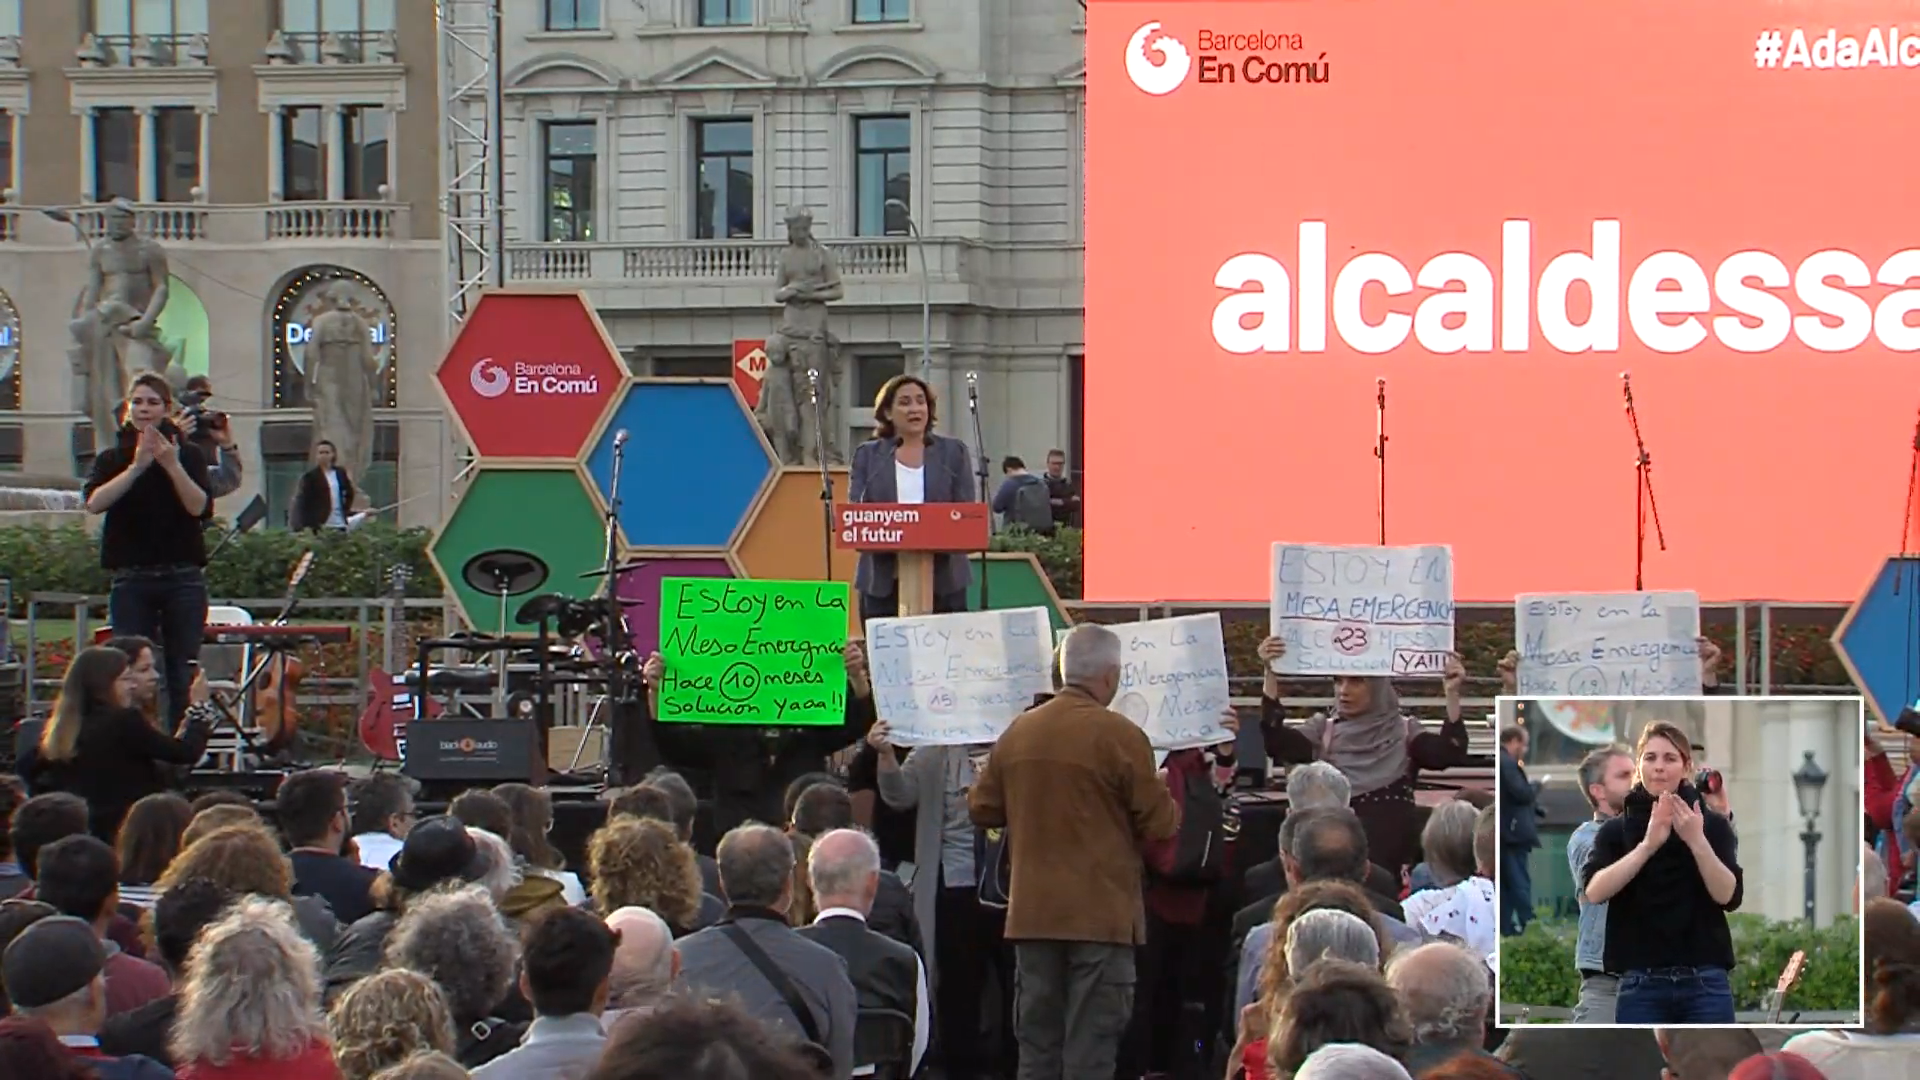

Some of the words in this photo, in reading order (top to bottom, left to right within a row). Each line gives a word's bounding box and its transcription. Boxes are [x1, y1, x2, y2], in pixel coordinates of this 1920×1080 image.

[1198, 30, 1303, 51] Barcelona
[1198, 56, 1235, 84] En
[1242, 52, 1330, 84] Comú
[515, 362, 581, 376] Barcelona
[749, 356, 767, 372] M
[515, 377, 540, 393] En
[542, 375, 598, 393] Comú
[842, 509, 919, 527] guanyem
[842, 527, 858, 543] el
[861, 527, 904, 543] futur
[1279, 547, 1390, 586] ESTOY
[1408, 555, 1446, 584] EN
[775, 594, 805, 611] en
[1285, 591, 1341, 618] MESA
[1130, 635, 1157, 652] en
[1333, 627, 1368, 651] 23
[661, 666, 715, 693] Hace
[724, 671, 755, 690] 10
[764, 668, 825, 685] meses
[930, 694, 953, 708] 15
